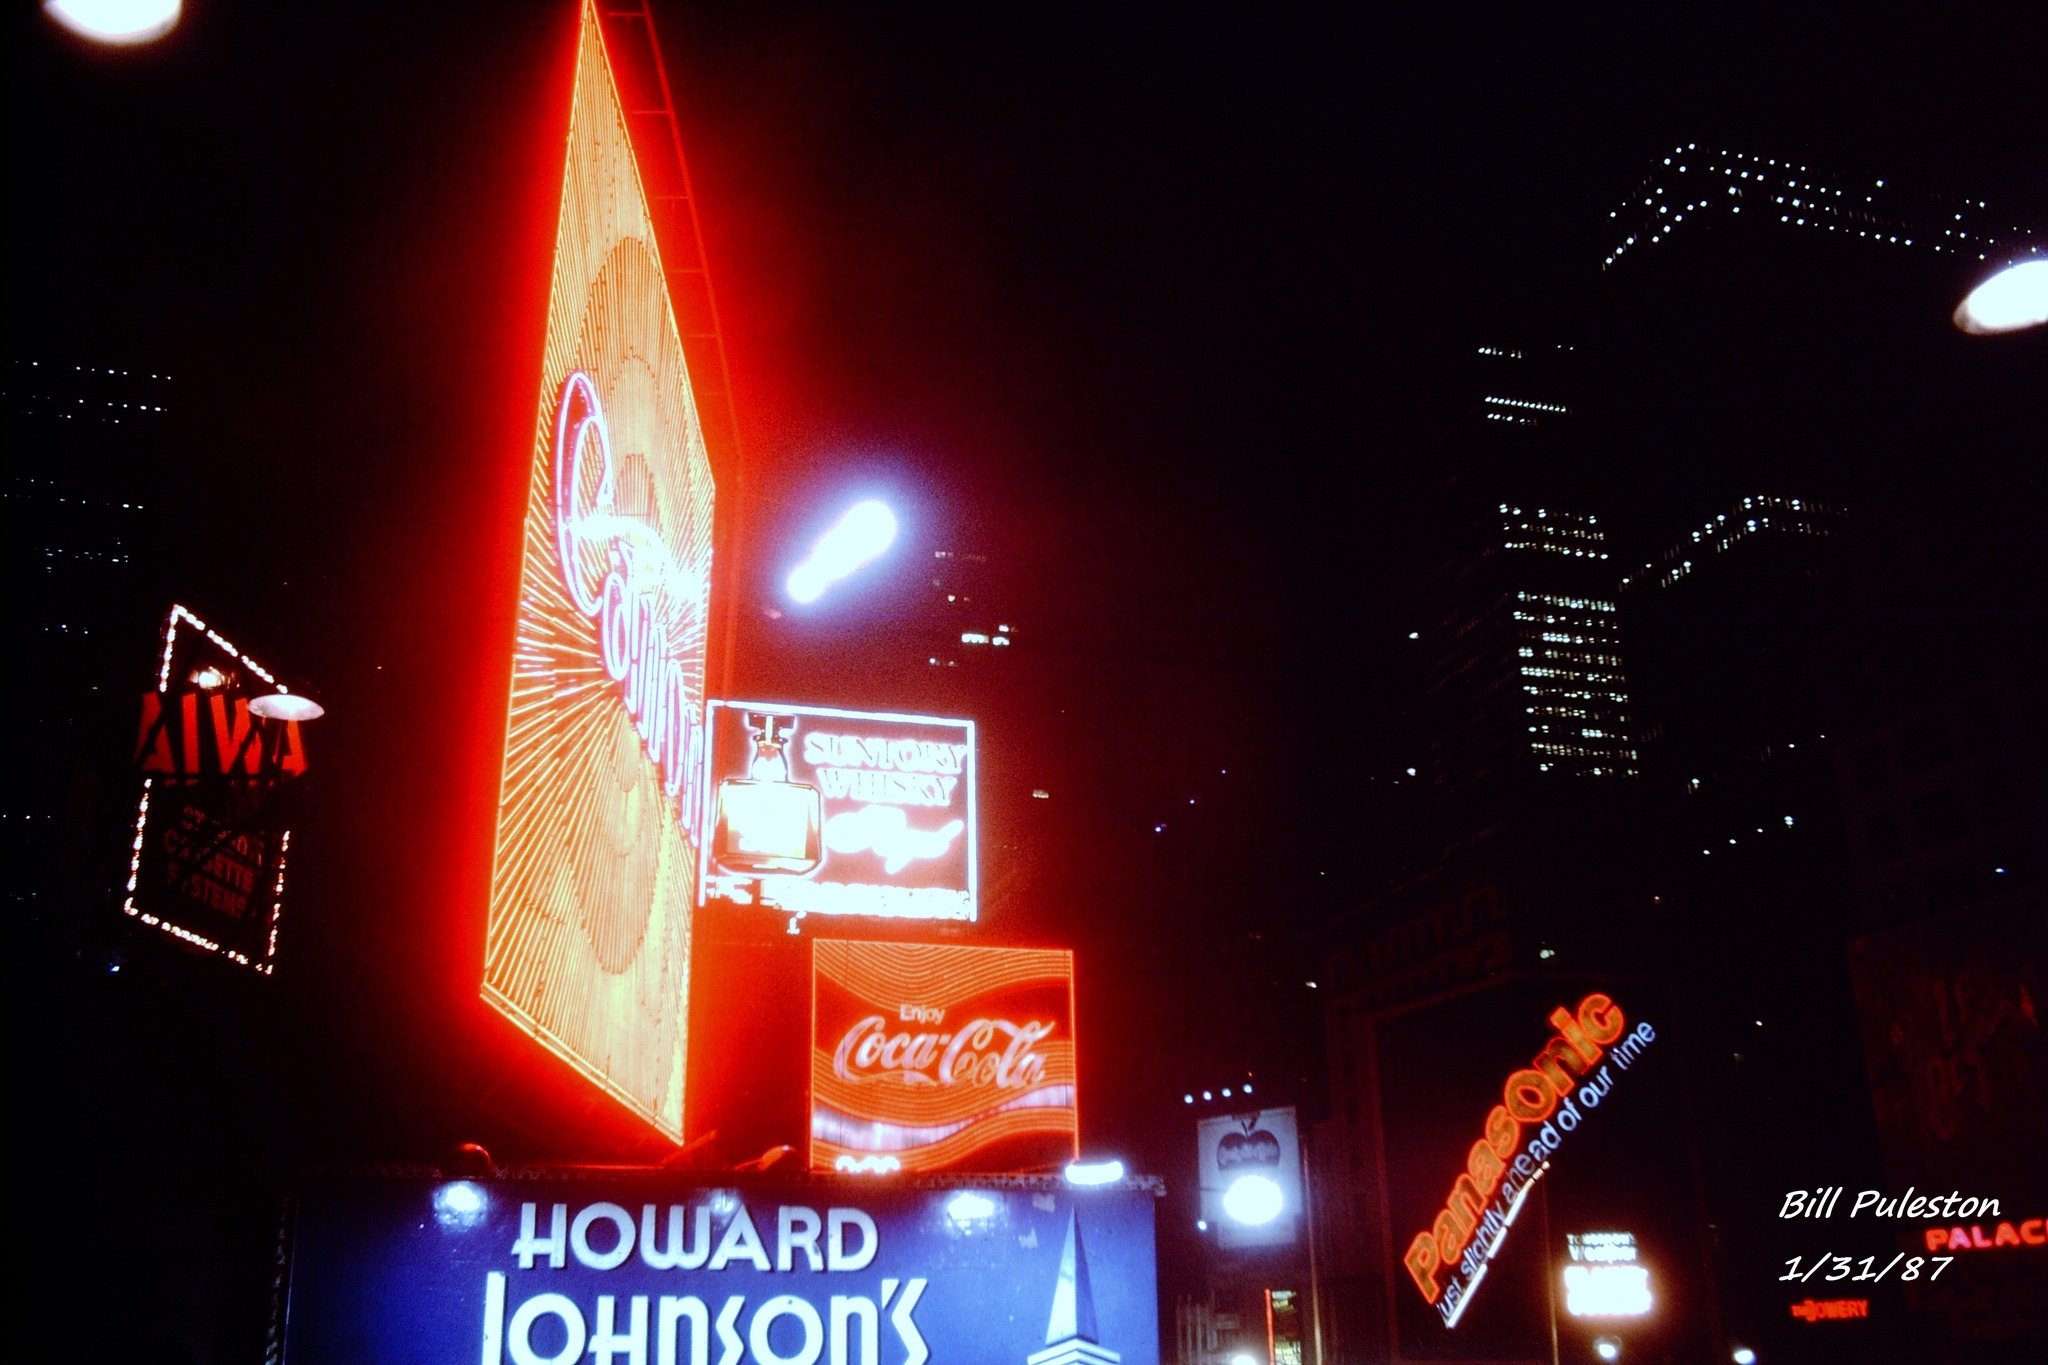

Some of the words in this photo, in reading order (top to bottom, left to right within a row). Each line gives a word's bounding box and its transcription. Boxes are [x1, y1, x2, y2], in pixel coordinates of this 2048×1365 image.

[556, 372, 702, 846] Canon
[134, 692, 308, 777] AIWA
[804, 732, 968, 774] SUNTORY
[816, 768, 958, 806] WHISKY
[163, 828, 254, 894] CASETTE
[900, 1004, 945, 1024] Enjoy
[833, 1016, 1055, 1088] Coca-Cola
[1557, 1097, 1583, 1131] of
[1579, 1065, 1615, 1108] our
[1610, 1021, 1656, 1070] time
[1404, 993, 1625, 1304] Panasonic
[511, 1202, 880, 1272] HOWARD
[1925, 1219, 2048, 1251] PALAC
